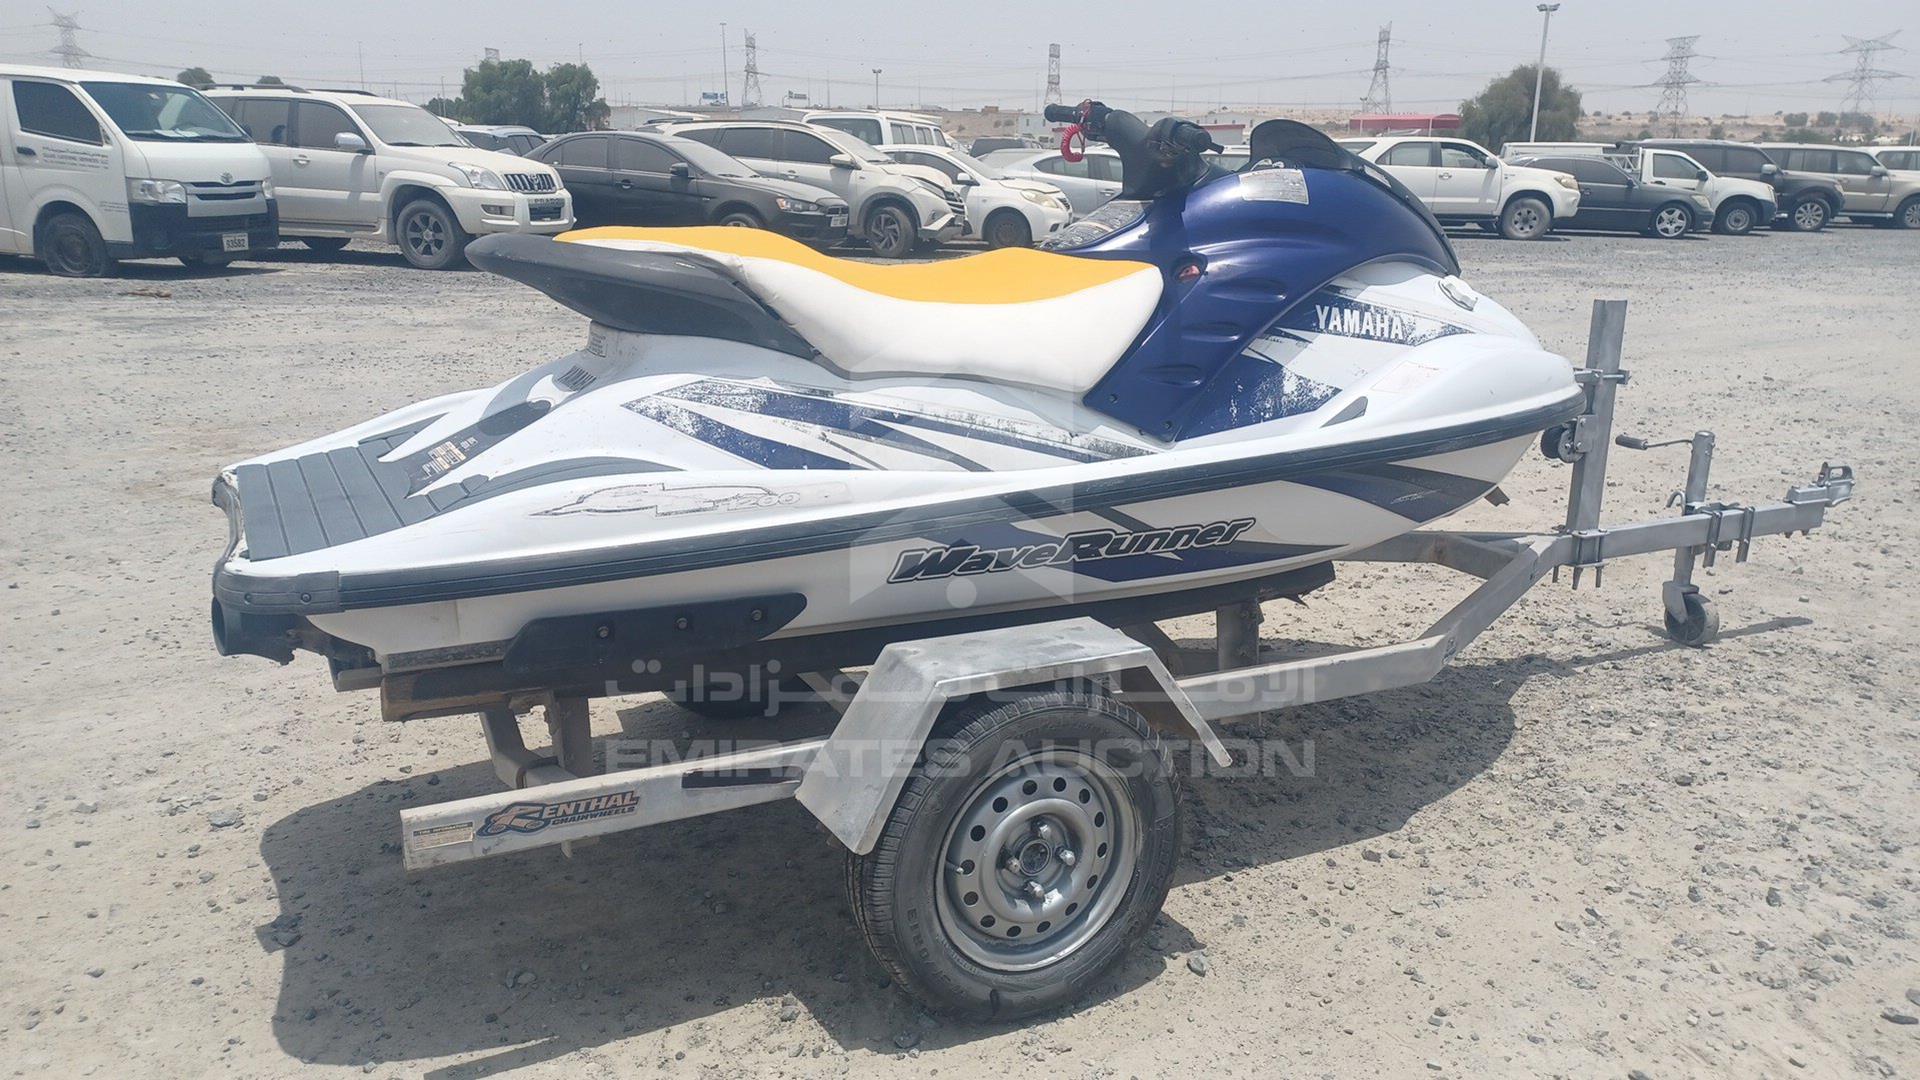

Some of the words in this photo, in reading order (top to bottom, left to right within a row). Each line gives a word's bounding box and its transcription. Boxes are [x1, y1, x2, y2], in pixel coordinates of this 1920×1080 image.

[1315, 304, 1404, 340] YAMAHA
[887, 517, 1256, 584] WaveRunner
[551, 805, 637, 827] CHAINWHEELS
